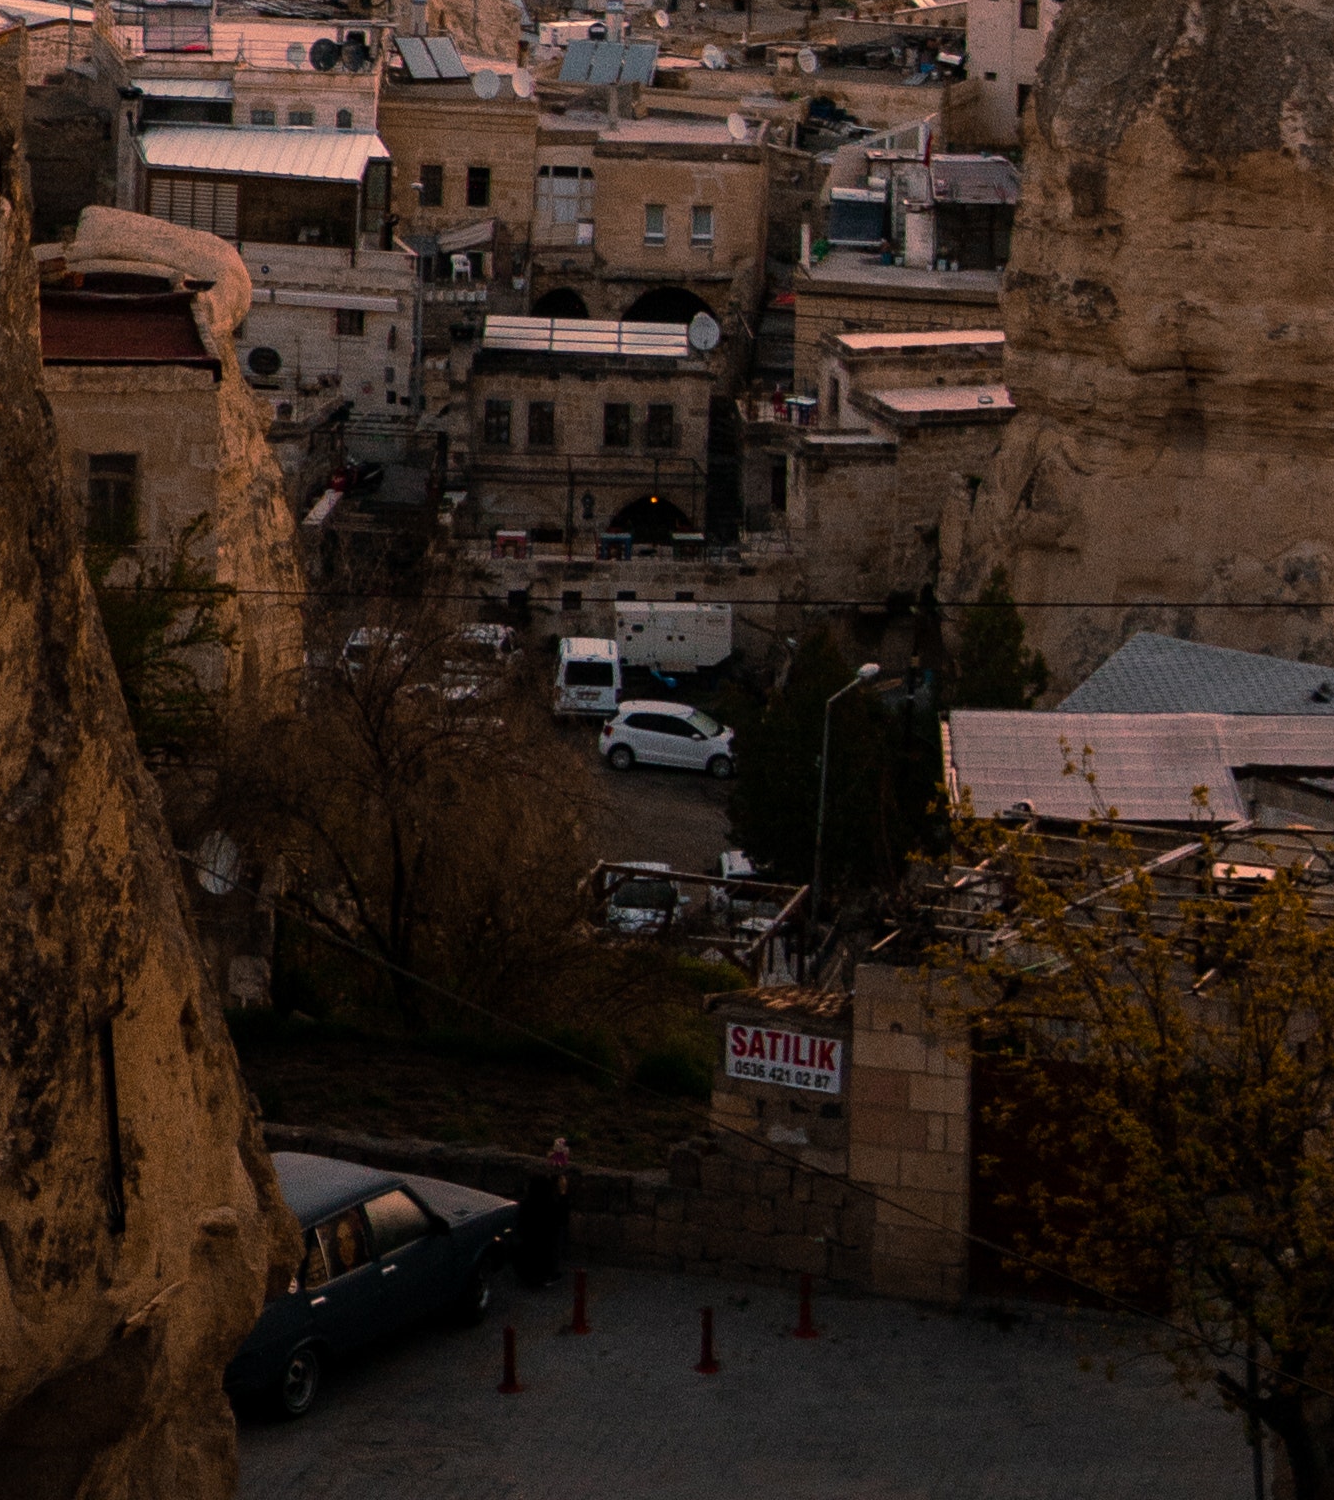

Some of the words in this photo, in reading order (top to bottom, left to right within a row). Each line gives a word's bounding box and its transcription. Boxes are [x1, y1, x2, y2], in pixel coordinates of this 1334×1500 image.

[732, 1026, 835, 1071] SATILIK
[735, 1060, 766, 1078] 0536
[769, 1066, 791, 1083] 421
[795, 1071, 812, 1087] 02
